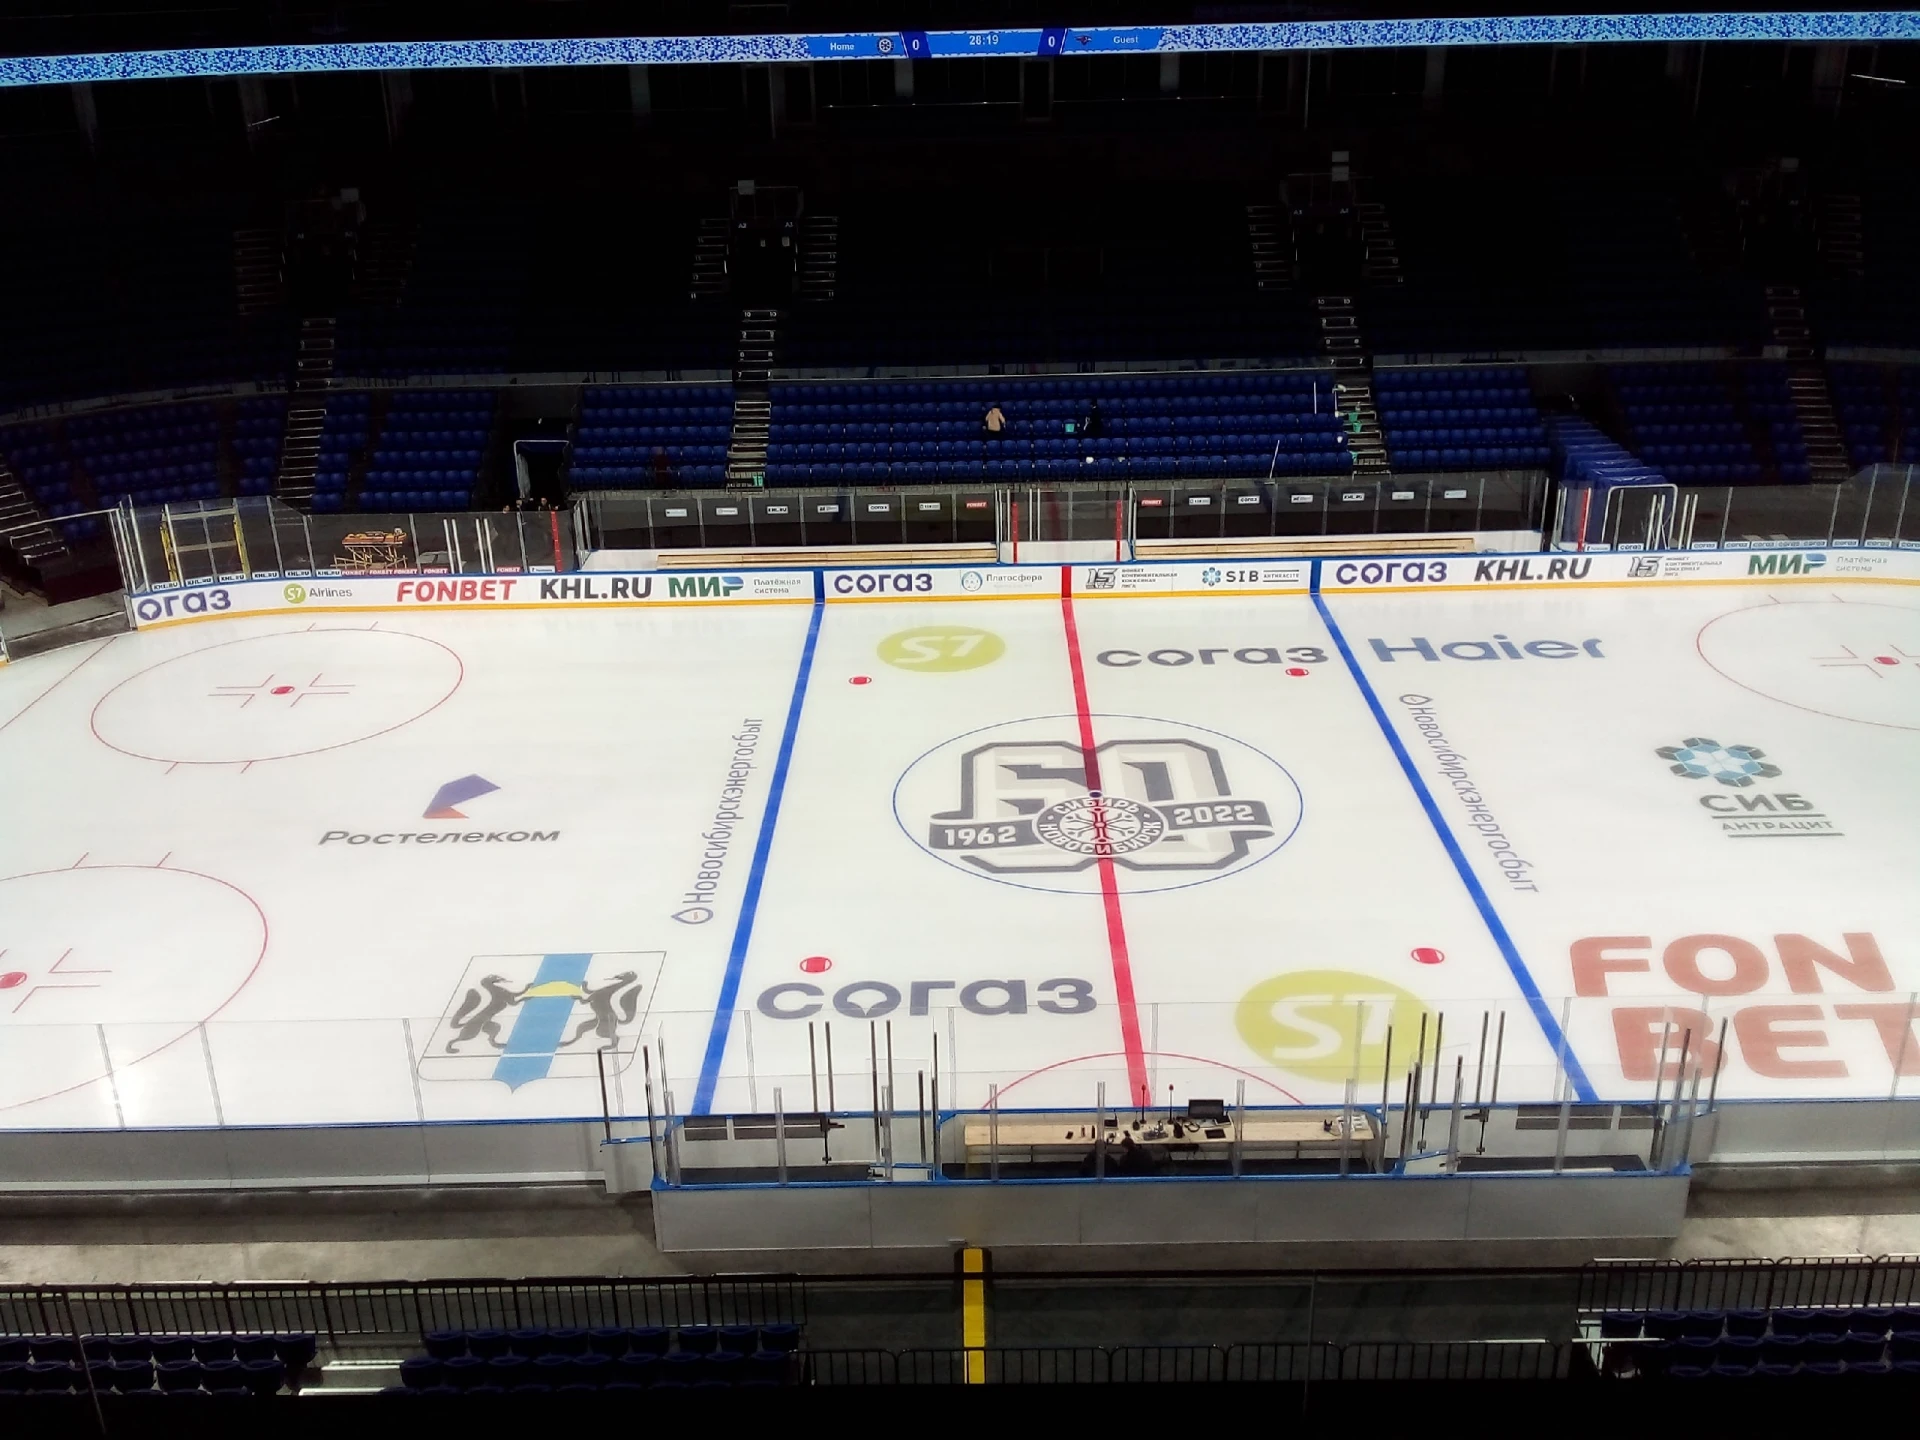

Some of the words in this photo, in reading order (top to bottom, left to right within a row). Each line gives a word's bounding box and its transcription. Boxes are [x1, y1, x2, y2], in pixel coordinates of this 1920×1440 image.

[829, 41, 856, 51] Home
[912, 39, 920, 51] 0
[969, 34, 999, 46] 28:19
[1048, 36, 1056, 48] 0
[1113, 35, 1139, 46] Guest
[1336, 562, 1447, 585] согаз
[1474, 558, 1592, 582] KHL.RU
[1748, 552, 1828, 576] МИР
[1836, 564, 1873, 572] система
[668, 575, 745, 598] МИР
[753, 577, 801, 587] Платёжная
[834, 573, 933, 593] согаз
[986, 573, 1043, 583] Платосфера
[1226, 570, 1259, 582] SIB
[286, 586, 303, 601] S7
[309, 587, 353, 598] Airlines
[396, 579, 517, 602] FONBET
[540, 577, 652, 600] KHL.RU
[892, 634, 986, 664] S7
[1096, 646, 1329, 667] согаз
[1367, 634, 1606, 663] Haier
[1055, 797, 1141, 816] СИБИРЬ
[1408, 707, 1540, 893] Новосибирскэнергосбыт
[1700, 793, 1815, 812] СИБ
[682, 718, 763, 904] Новосибирскэнергосбыт
[1173, 804, 1256, 826] 2022
[944, 825, 1017, 846] 1962
[1722, 821, 1834, 831] АНТРАЦИТ
[318, 830, 560, 846] Ростелеком
[1038, 822, 1163, 855] НОВОСИБИРСК
[1569, 932, 1896, 997] FON
[756, 977, 1098, 1020] согаз
[1271, 994, 1397, 1060] S7
[1611, 1003, 1920, 1081] BET
